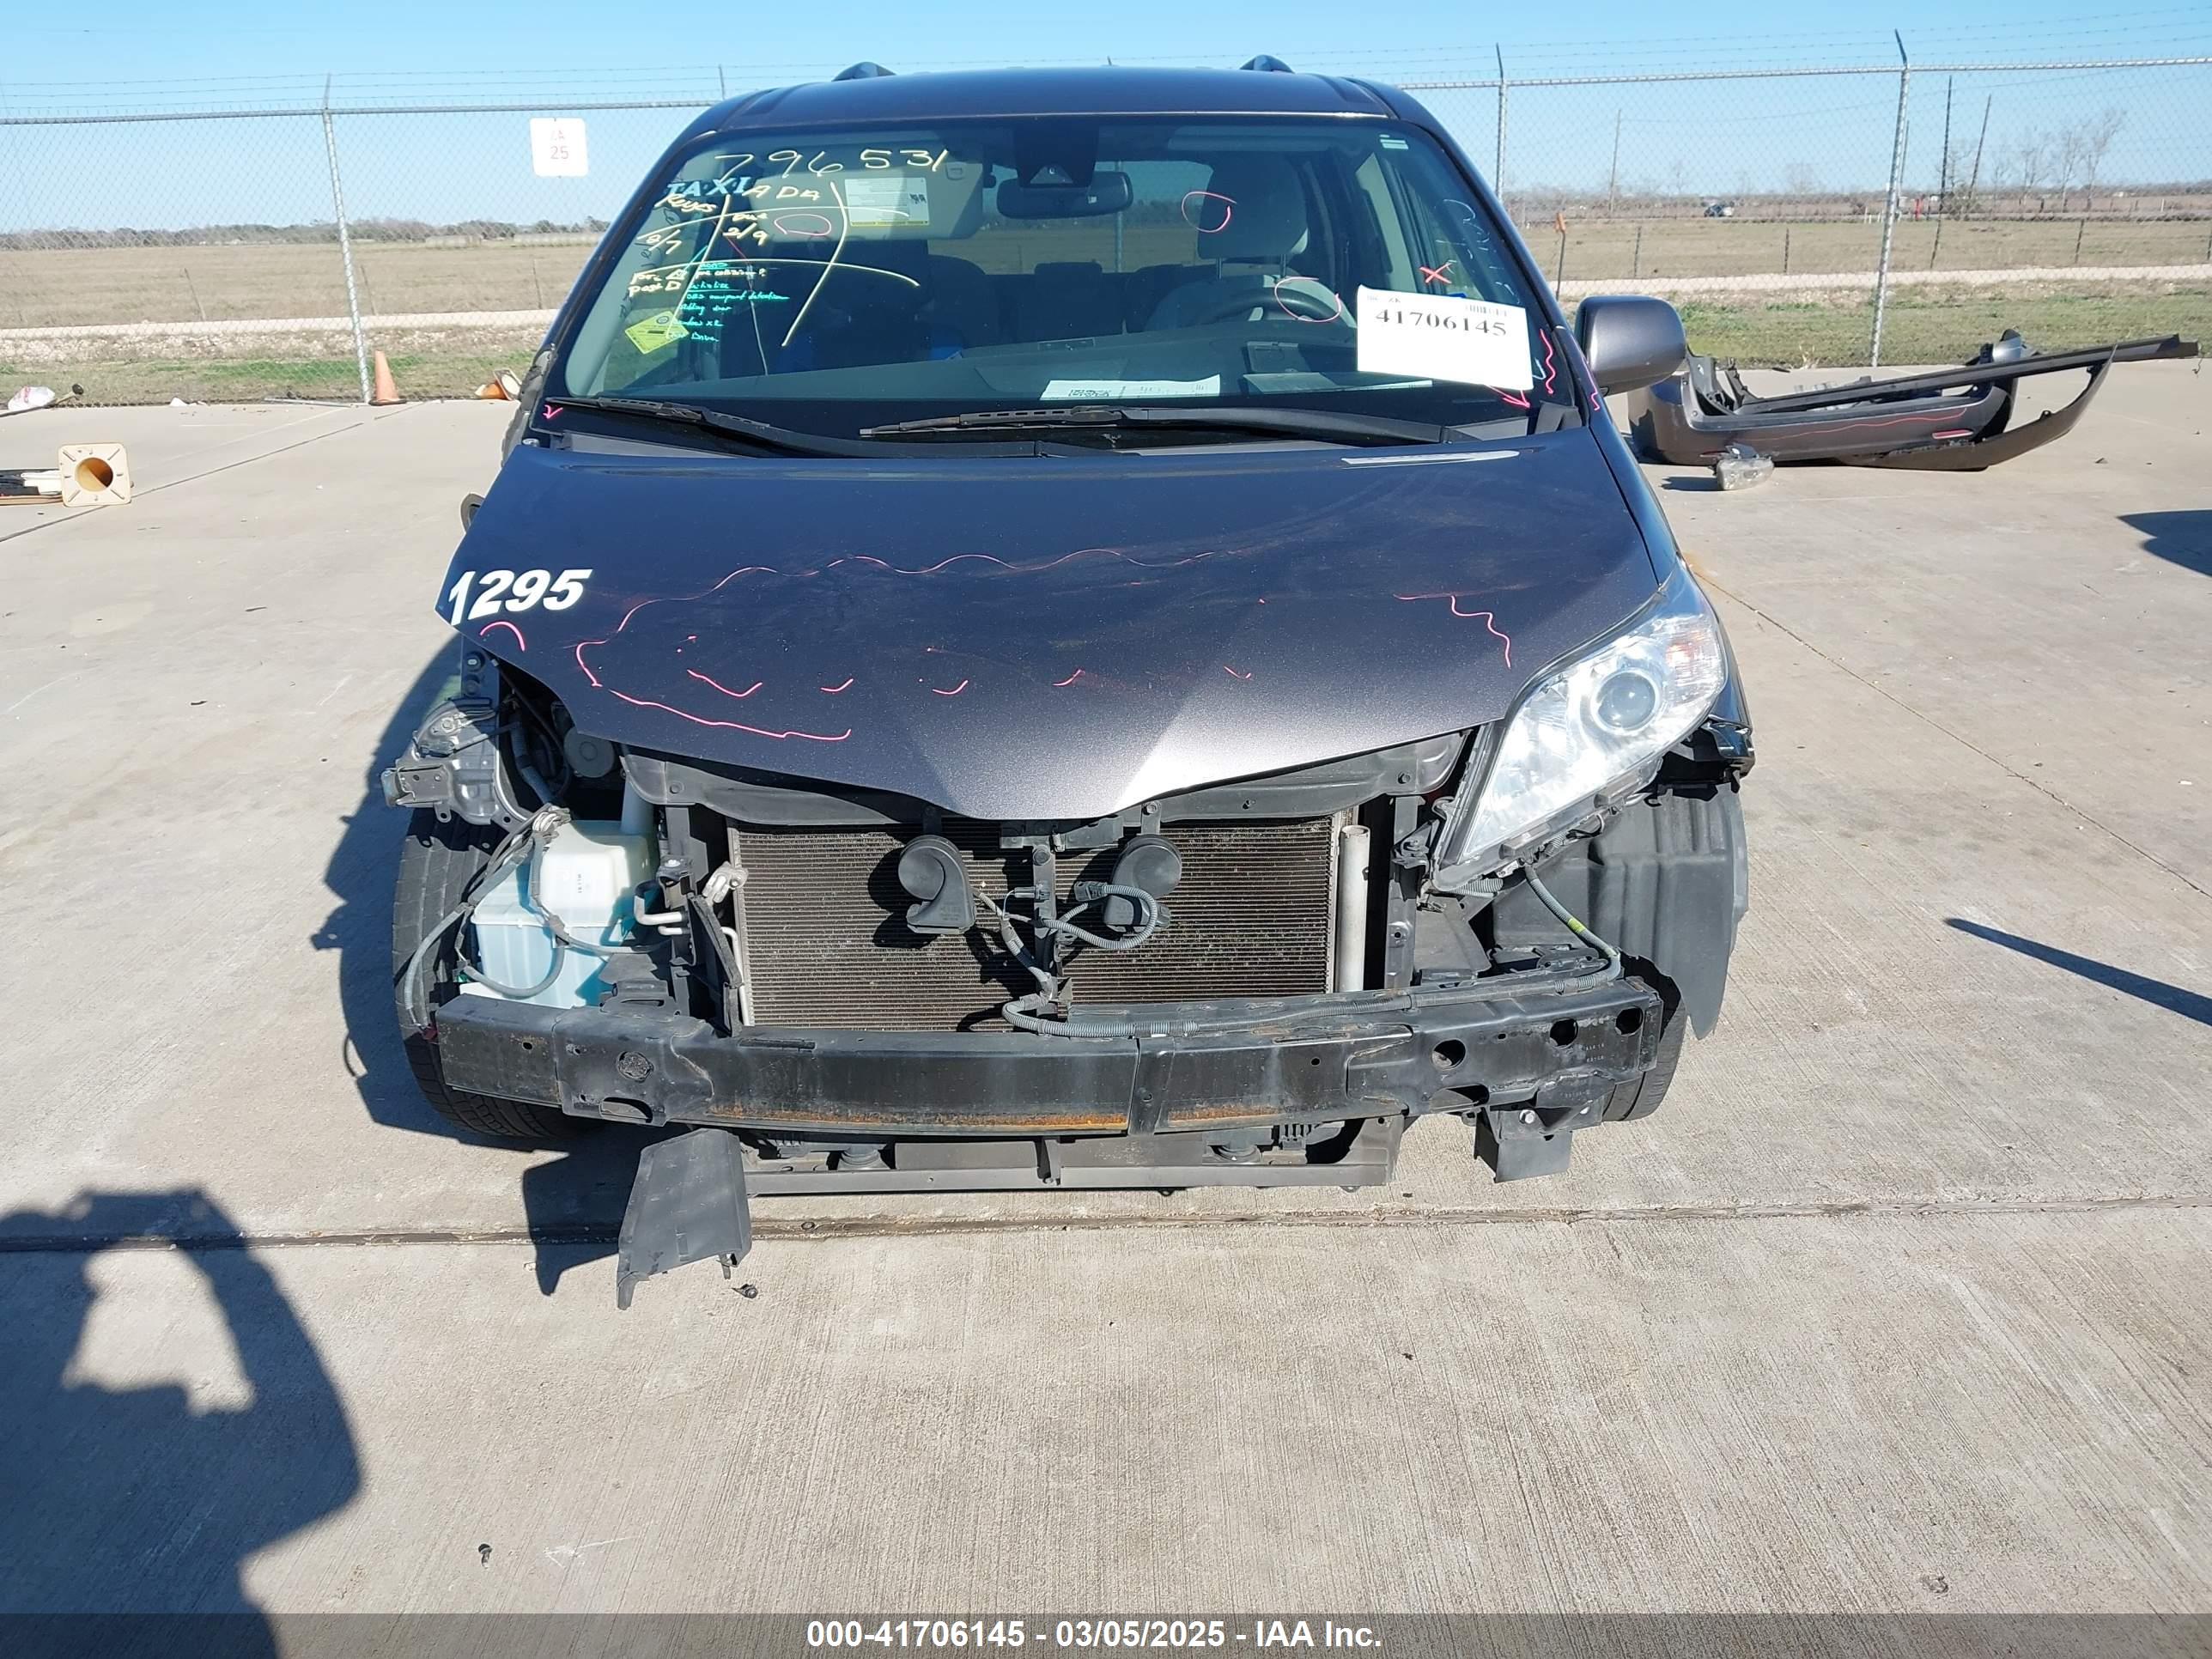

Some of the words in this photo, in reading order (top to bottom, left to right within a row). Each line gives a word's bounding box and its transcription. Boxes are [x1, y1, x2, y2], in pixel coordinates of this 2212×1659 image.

[550, 145, 569, 160] 25
[665, 176, 751, 197] TAXI
[1375, 308, 1507, 336] 41706145
[448, 568, 593, 626] 1295
